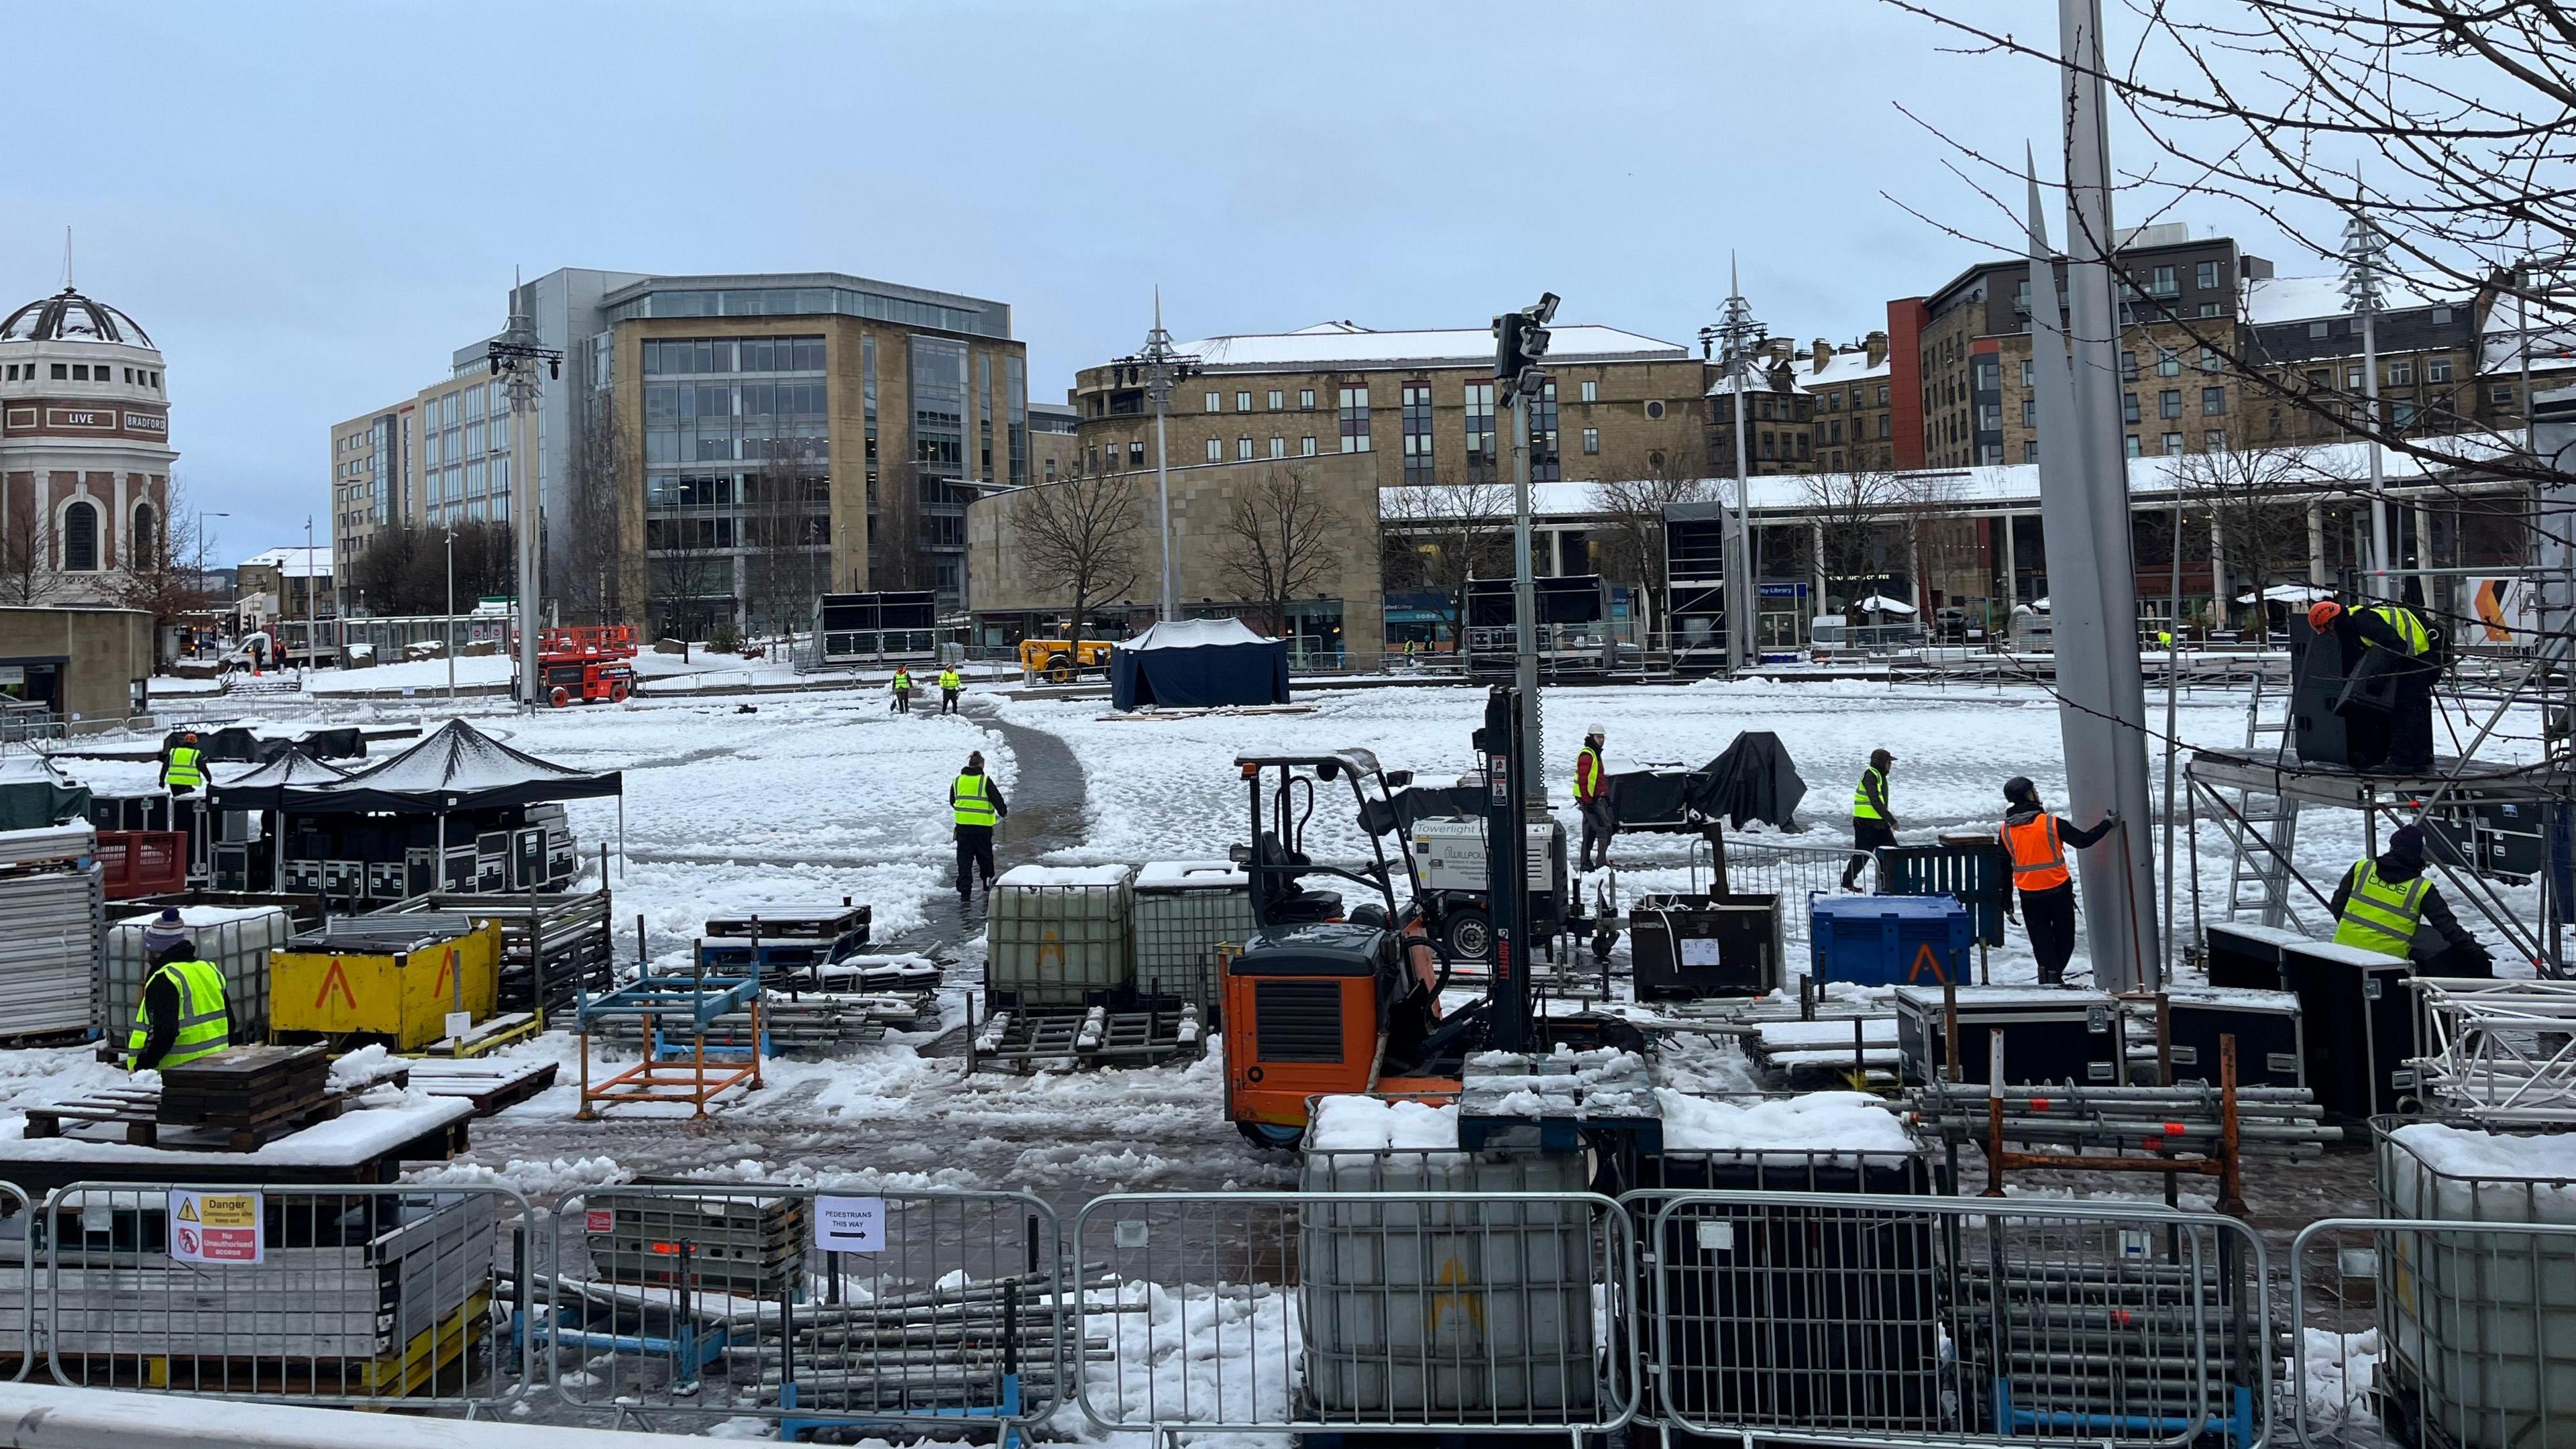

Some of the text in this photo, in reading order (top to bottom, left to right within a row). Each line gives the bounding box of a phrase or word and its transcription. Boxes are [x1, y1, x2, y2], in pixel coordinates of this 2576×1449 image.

[69, 413, 94, 424] LIVE
[127, 416, 165, 429] BRADFORD
[1214, 608, 1245, 618] TO LET
[1417, 824, 1474, 835] Towerlight
[1497, 941, 1510, 981] MOFFETT
[209, 1199, 246, 1211] Danger
[825, 1210, 872, 1218] PEDESTRIANS
[204, 1240, 254, 1248] Unauthorised
